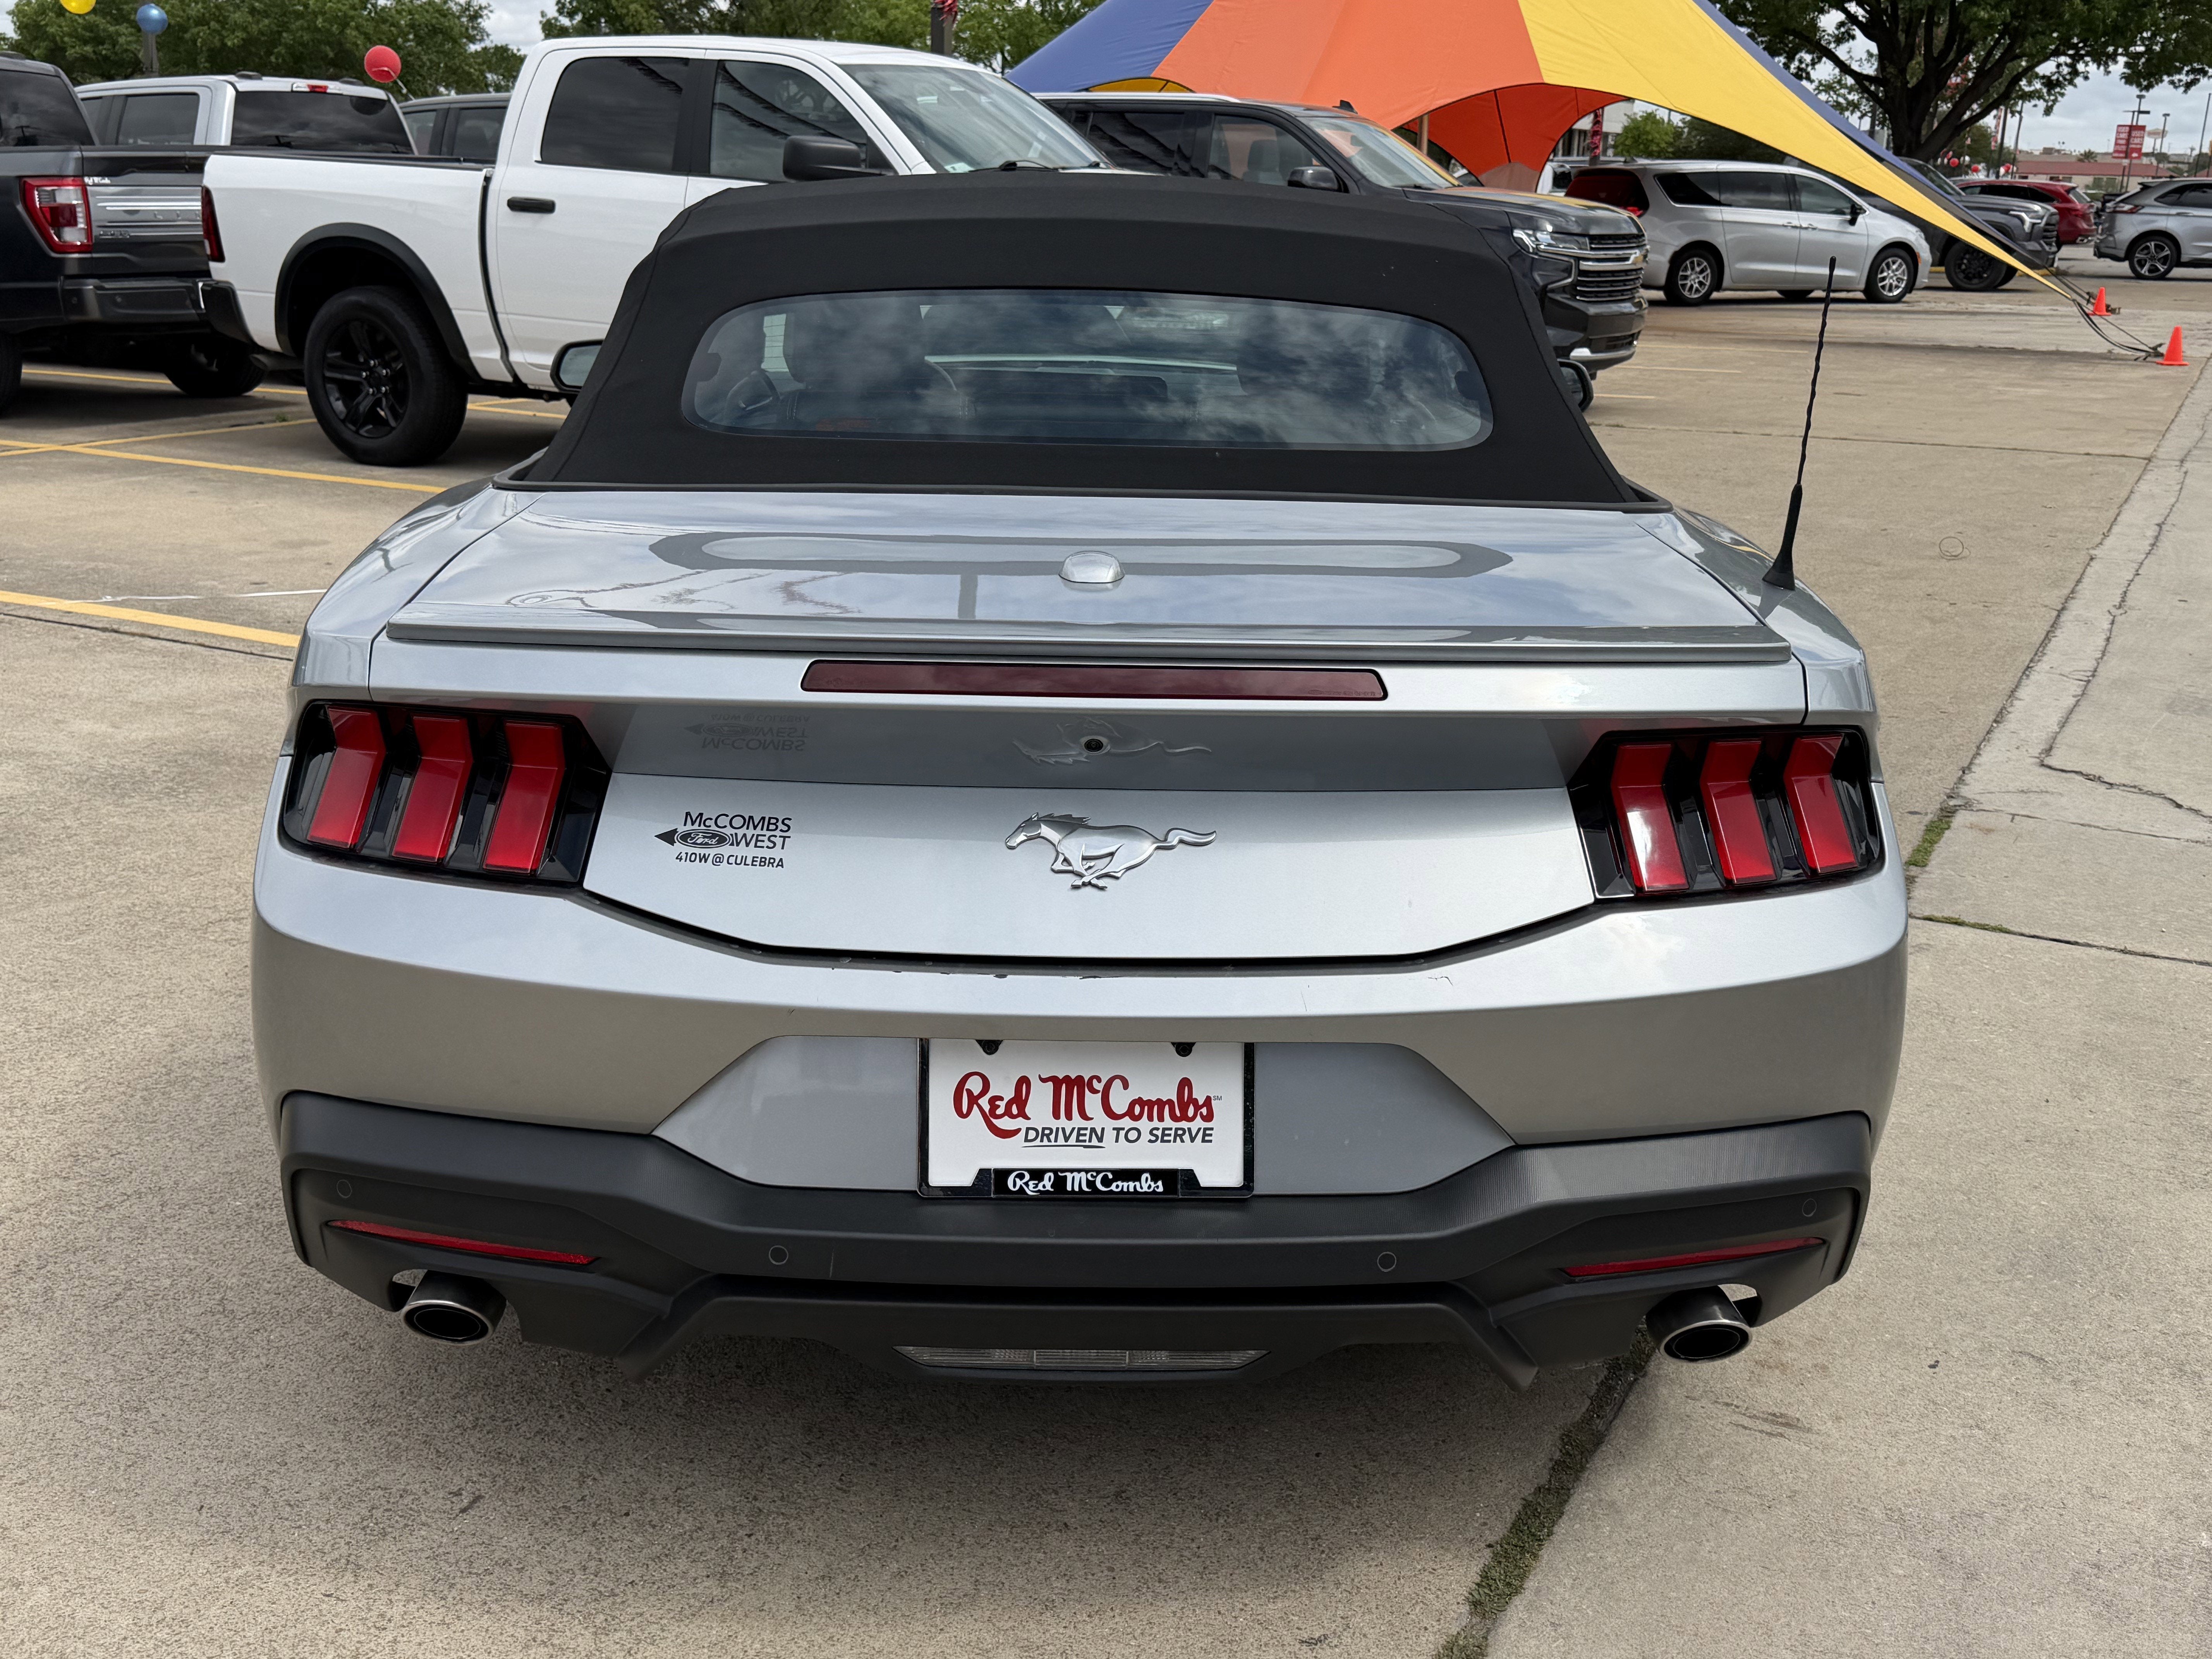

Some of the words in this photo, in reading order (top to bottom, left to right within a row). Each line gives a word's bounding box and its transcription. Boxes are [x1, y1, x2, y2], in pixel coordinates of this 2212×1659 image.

[684, 811, 792, 833] McCOMBS
[734, 832, 791, 850] WEST
[726, 855, 784, 869] CULEBRA
[953, 1071, 1031, 1139] Red
[1038, 1074, 1214, 1123] McCombs
[1024, 1127, 1105, 1143] DRIVEN
[1112, 1127, 1142, 1144] TO
[1147, 1127, 1214, 1144] SERVE
[1007, 1170, 1054, 1195] Red
[1058, 1171, 1164, 1193] McCombs
